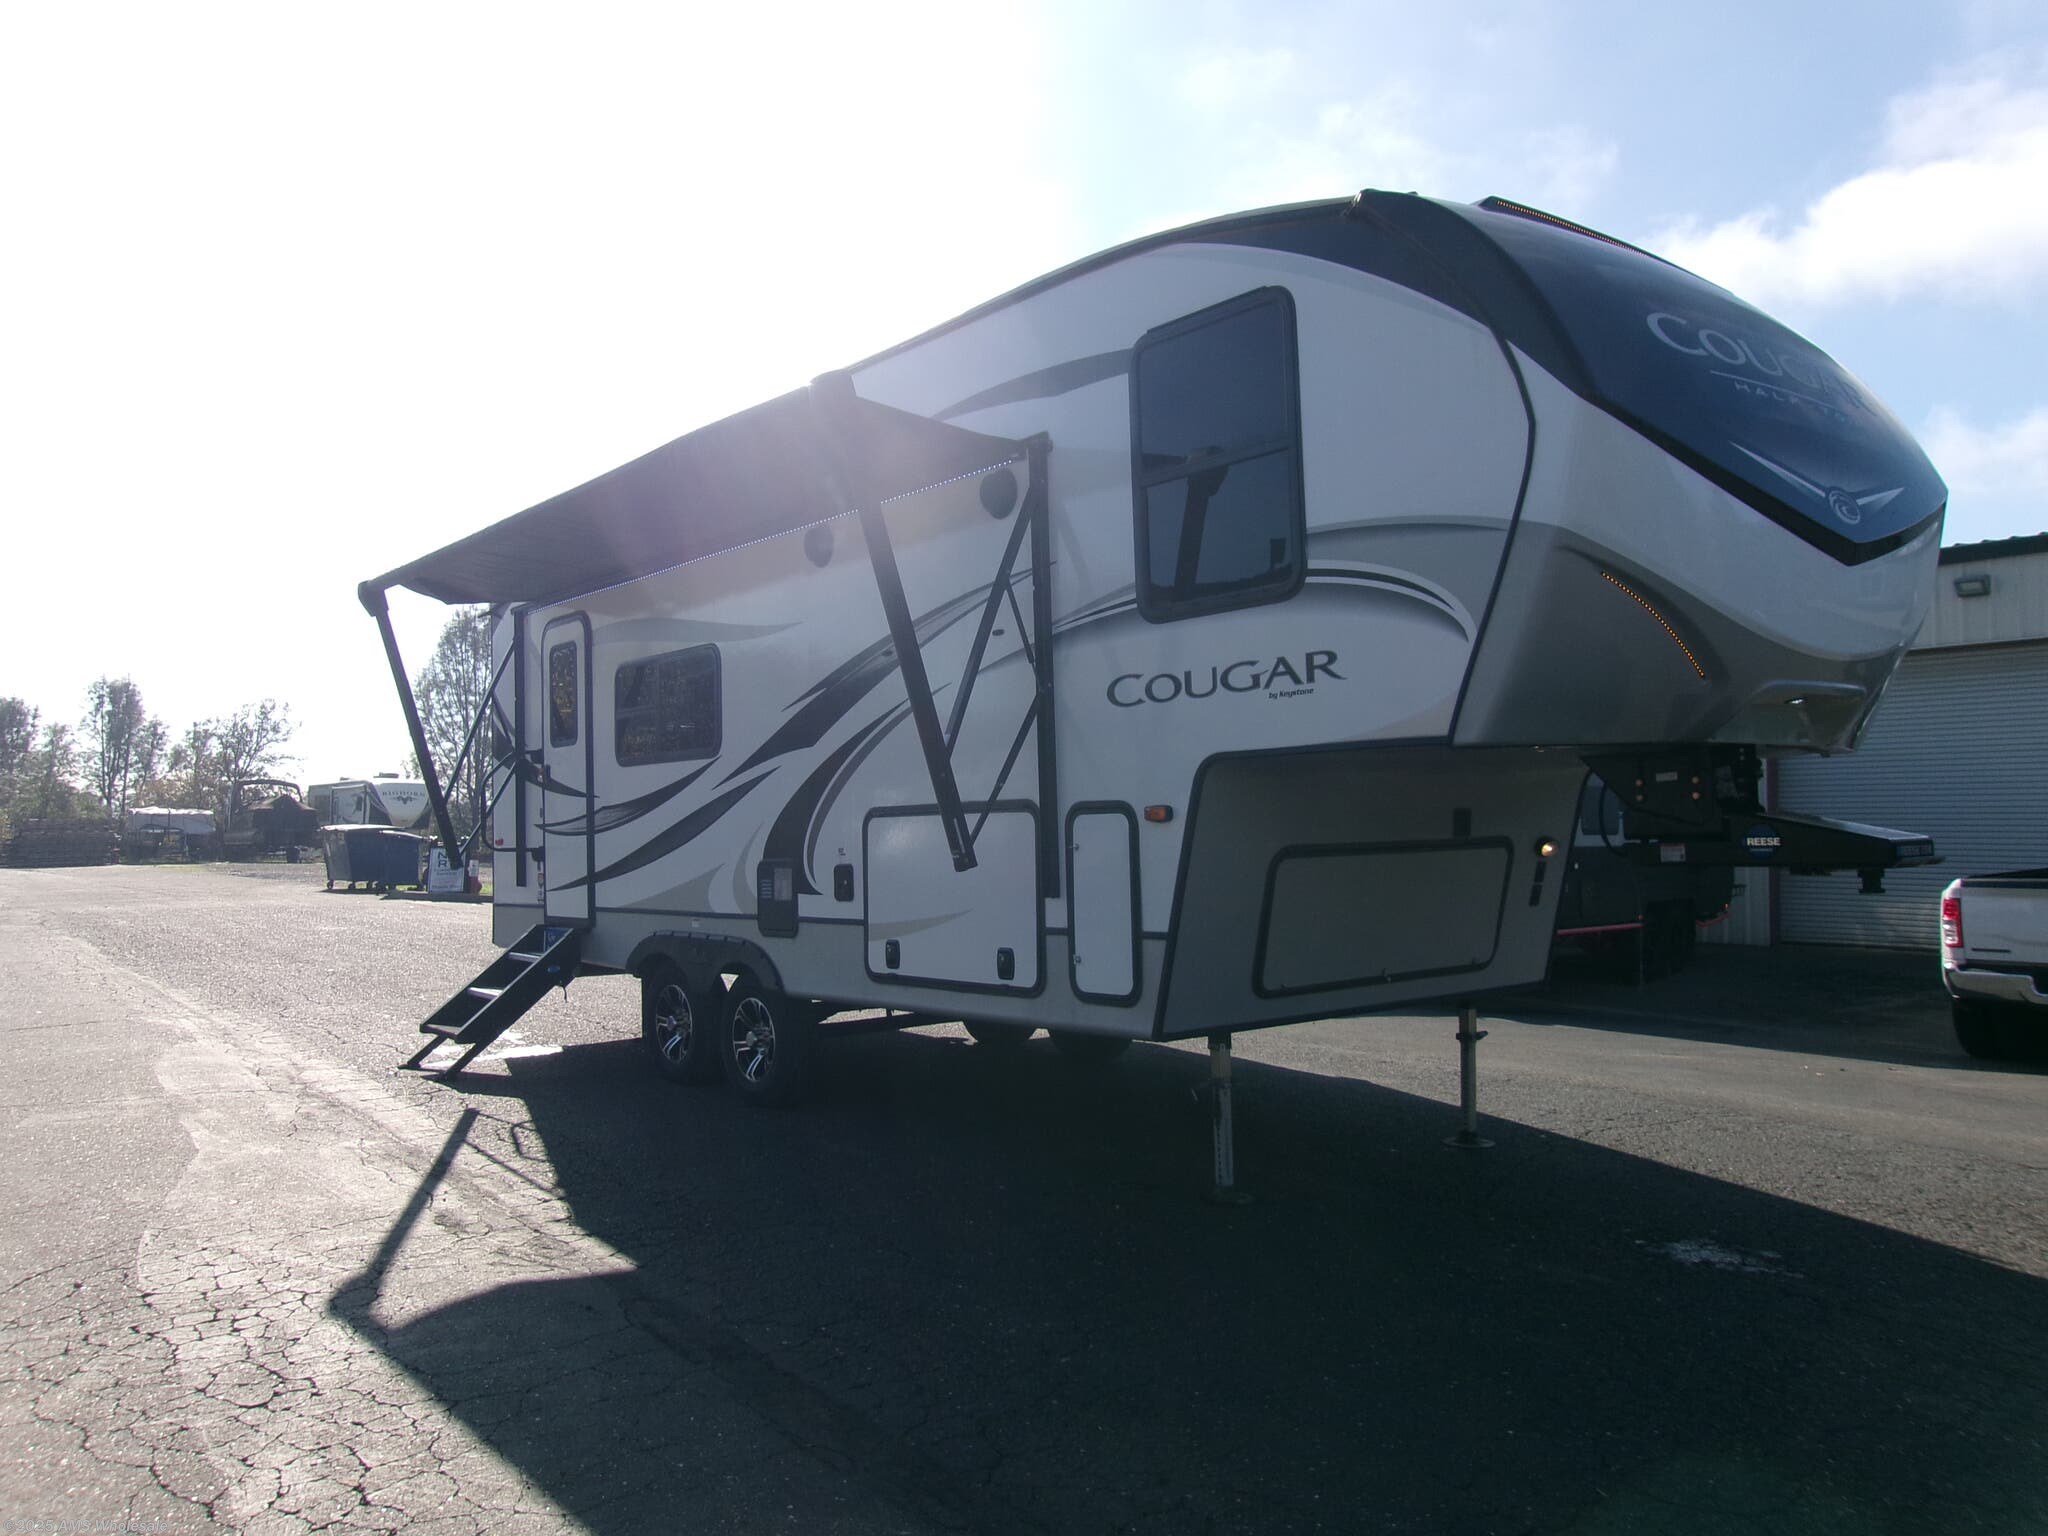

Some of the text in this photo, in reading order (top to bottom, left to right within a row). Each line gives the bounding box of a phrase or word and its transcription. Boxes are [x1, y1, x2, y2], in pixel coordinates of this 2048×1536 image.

[1106, 650, 1348, 708] COUGAR
[1268, 687, 1314, 699] by Keystone
[1746, 836, 1782, 847] REESE
